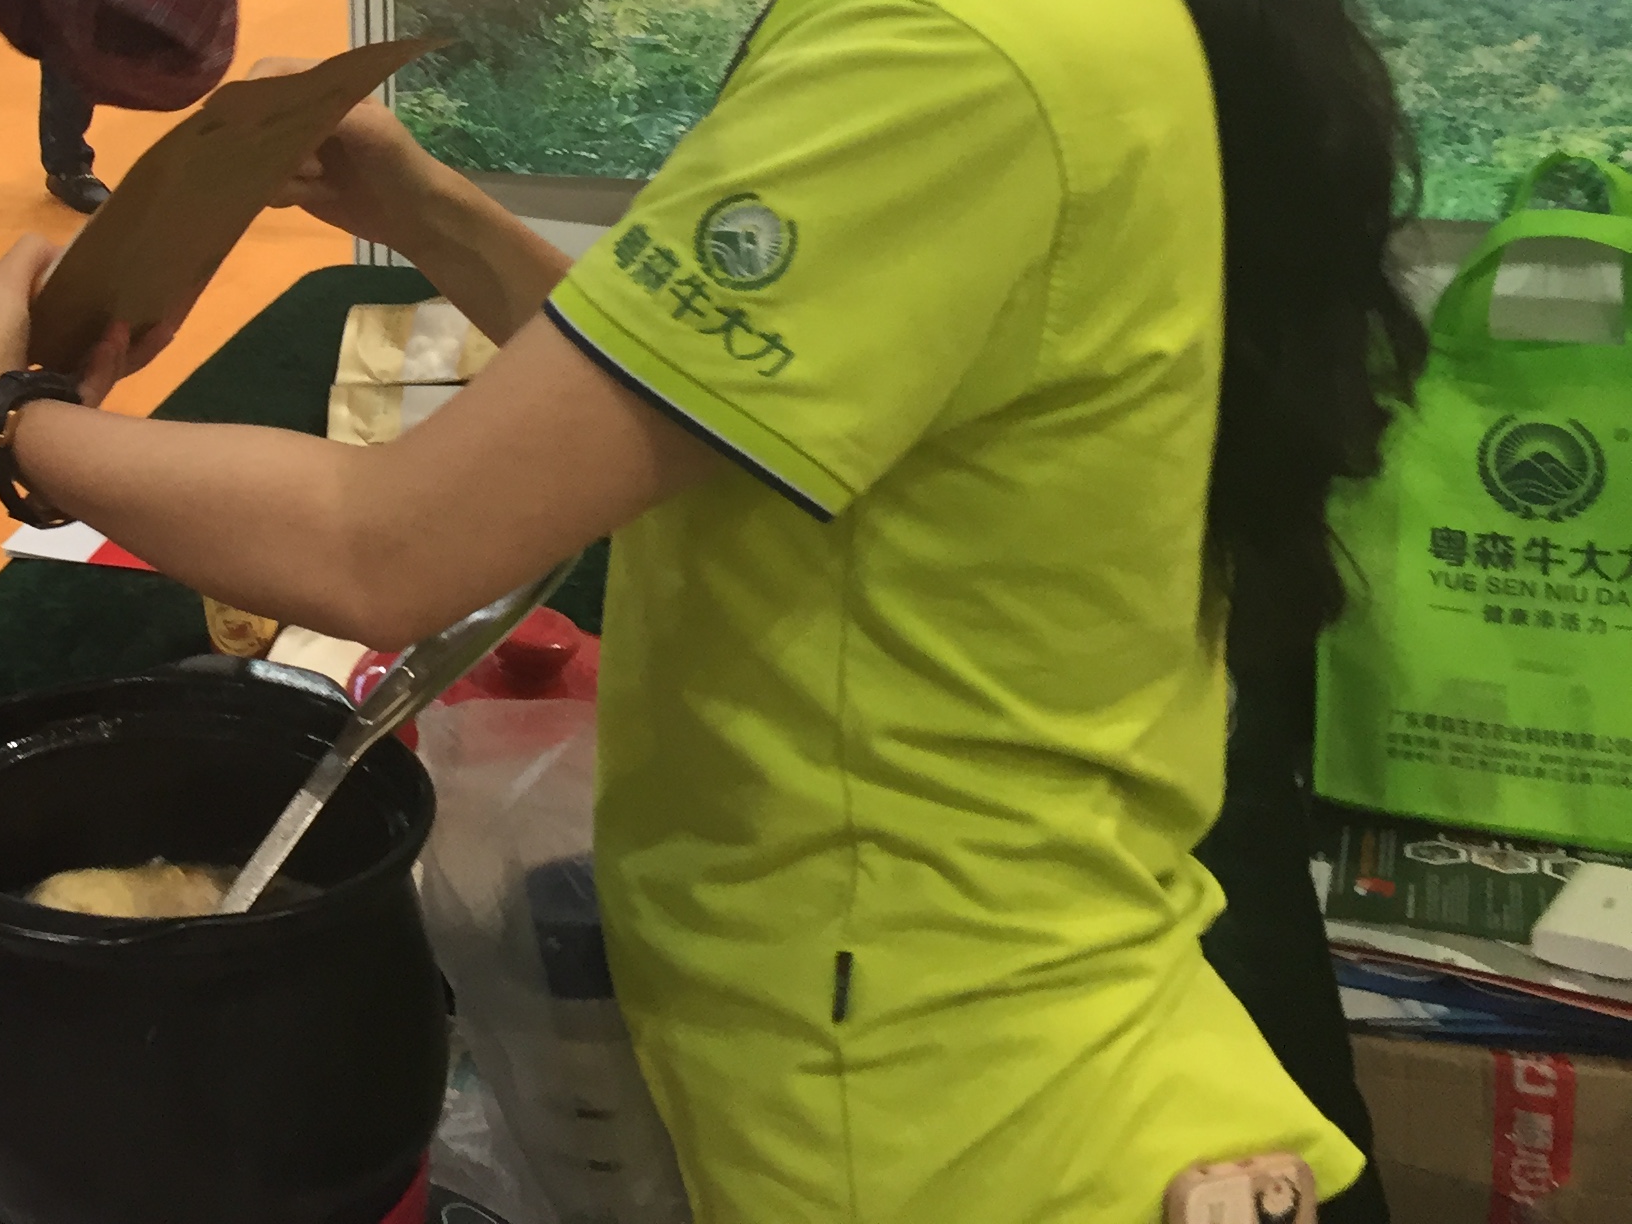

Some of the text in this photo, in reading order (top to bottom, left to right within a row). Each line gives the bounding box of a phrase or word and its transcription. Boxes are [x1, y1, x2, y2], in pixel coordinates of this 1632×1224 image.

[1427, 570, 1477, 594] YUE
[1485, 575, 1539, 599] SEN
[1544, 581, 1589, 604] NIU
